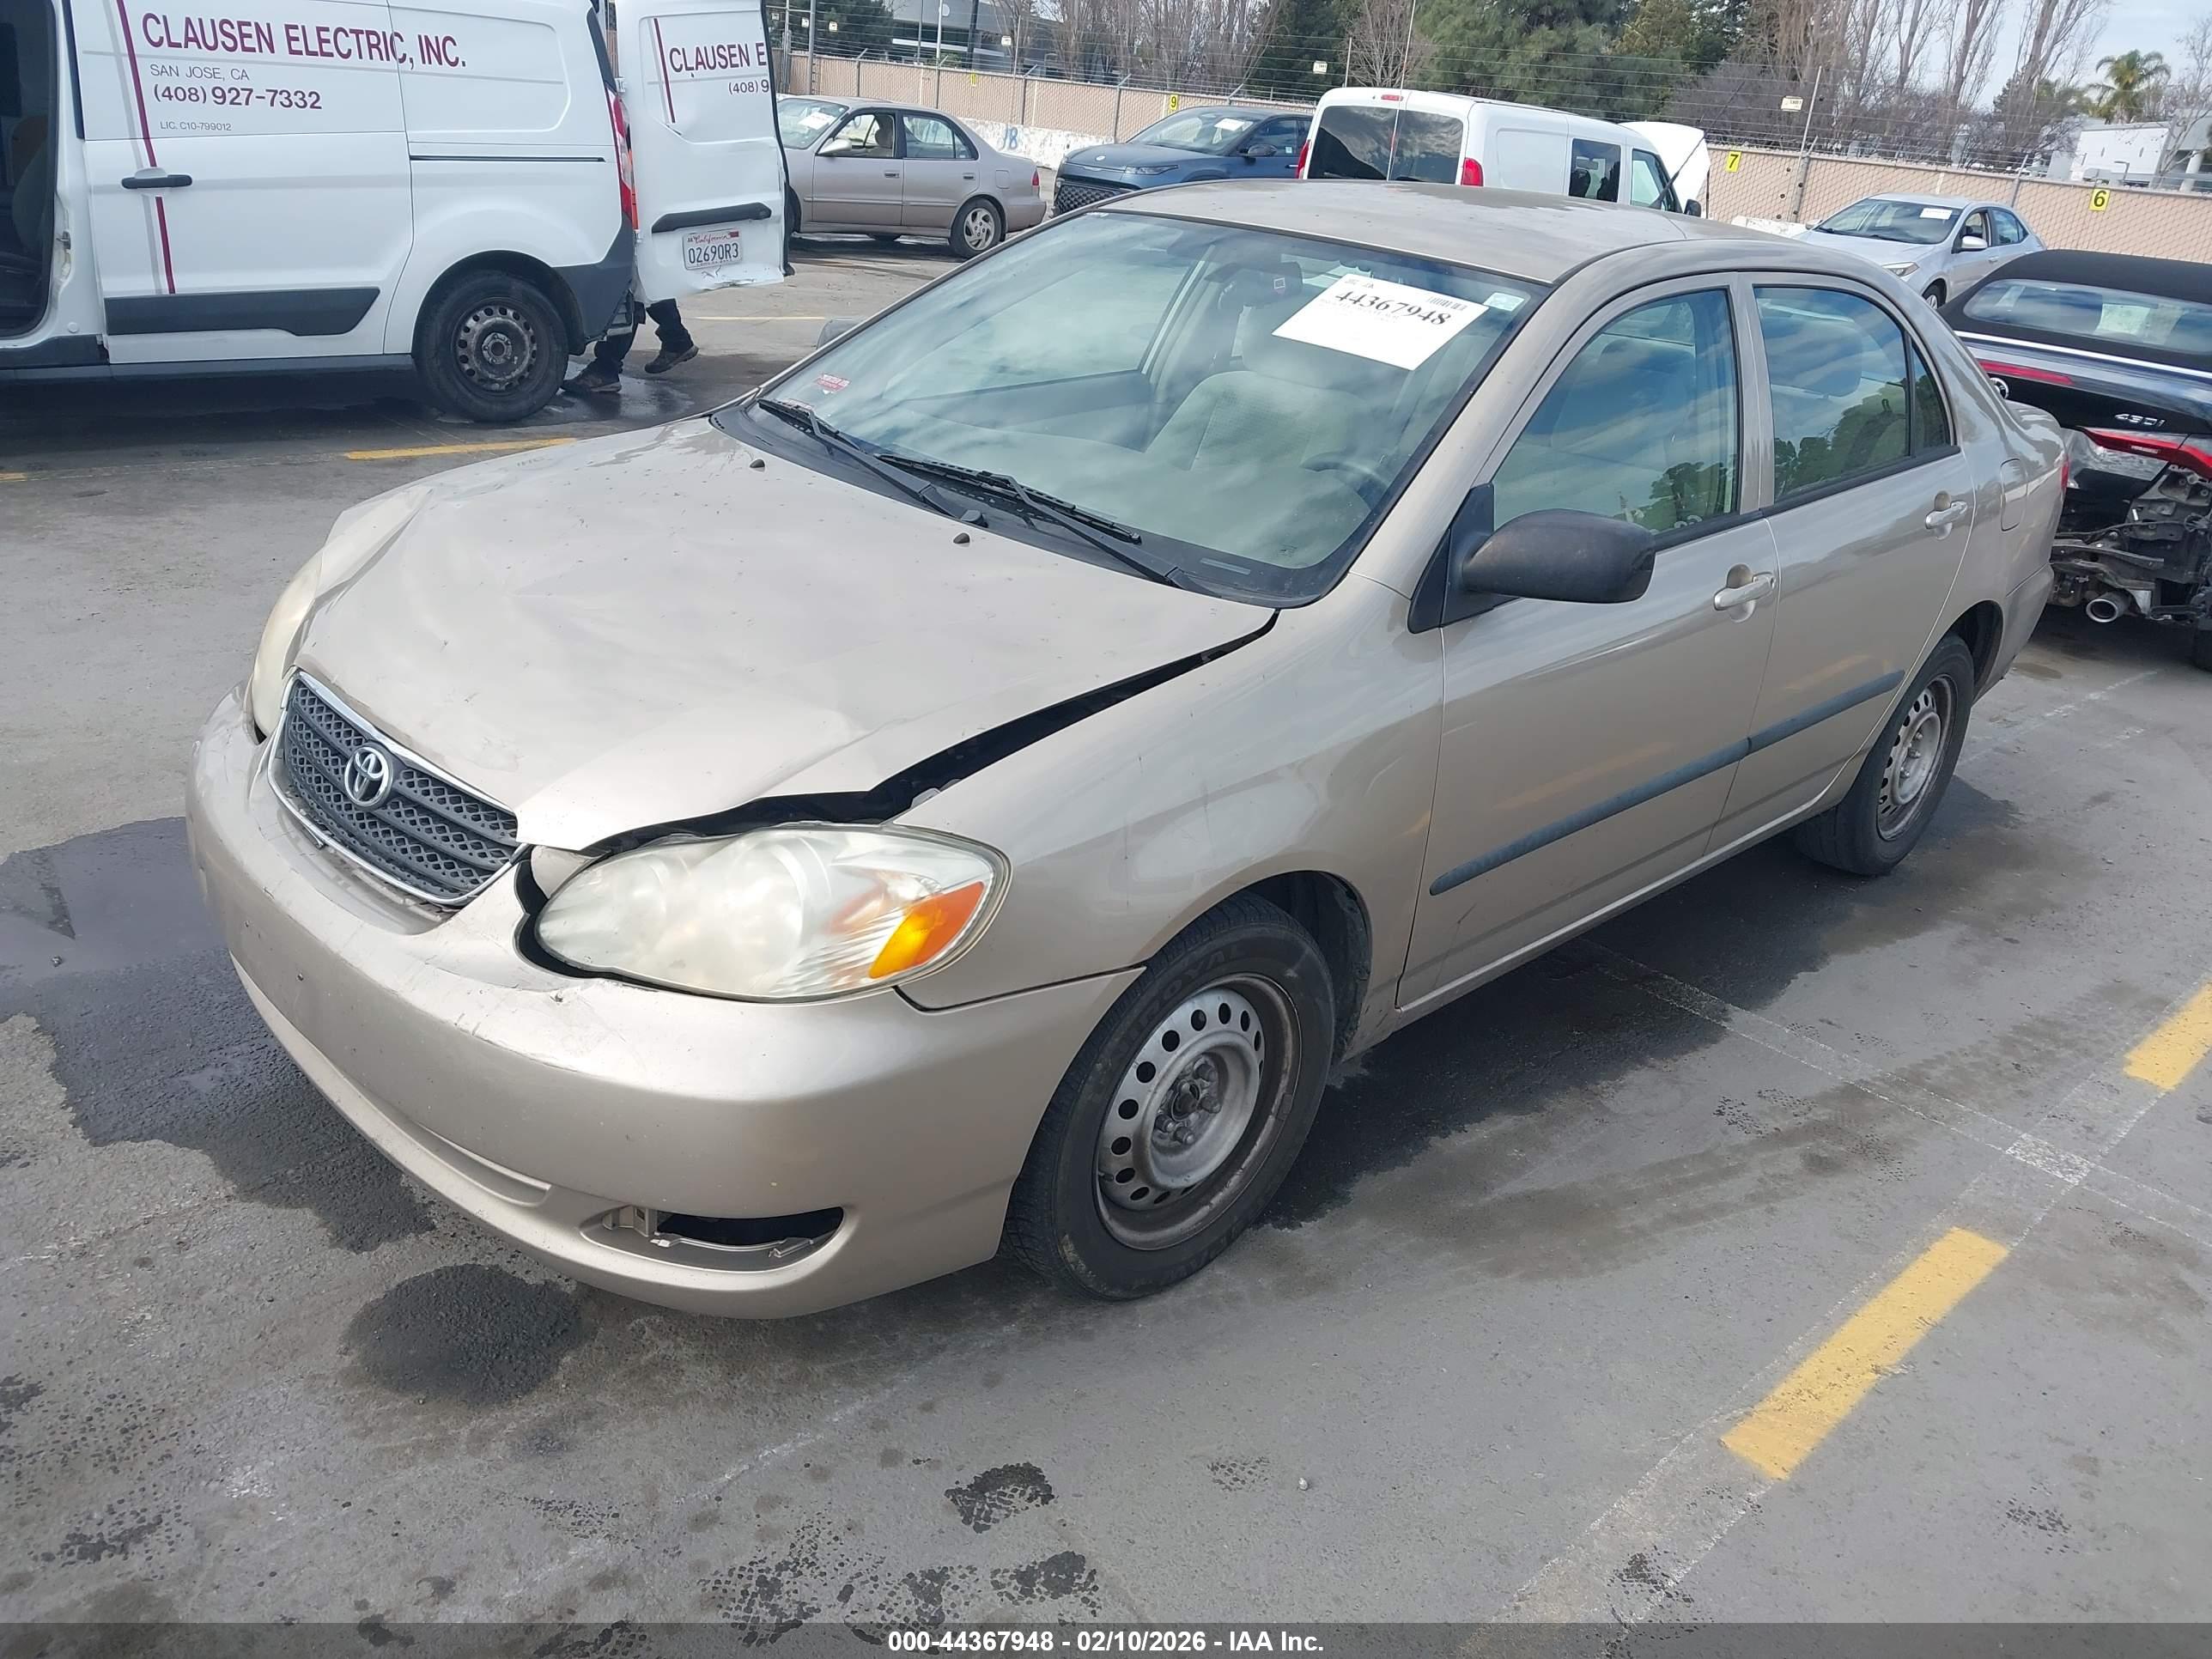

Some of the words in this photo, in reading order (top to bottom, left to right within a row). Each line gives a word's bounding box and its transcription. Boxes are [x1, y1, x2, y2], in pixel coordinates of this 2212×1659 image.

[142, 12, 276, 54] CLAUSEN
[283, 22, 415, 70] ELECTRIC,
[418, 33, 467, 68] INC.
[669, 43, 750, 73] CLAUSEN
[149, 64, 179, 78] SAN
[185, 65, 225, 82] JOSE,
[230, 69, 250, 81] CA
[153, 84, 208, 105] (408)
[211, 86, 323, 110] 927-7332
[728, 81, 759, 95] (408)
[1170, 95, 1177, 109] 9
[160, 121, 178, 131] LIC.
[179, 122, 232, 131] C10-799012
[1729, 153, 1739, 168] 7
[2094, 189, 2107, 207] 6
[1335, 290, 1452, 325] 44367948
